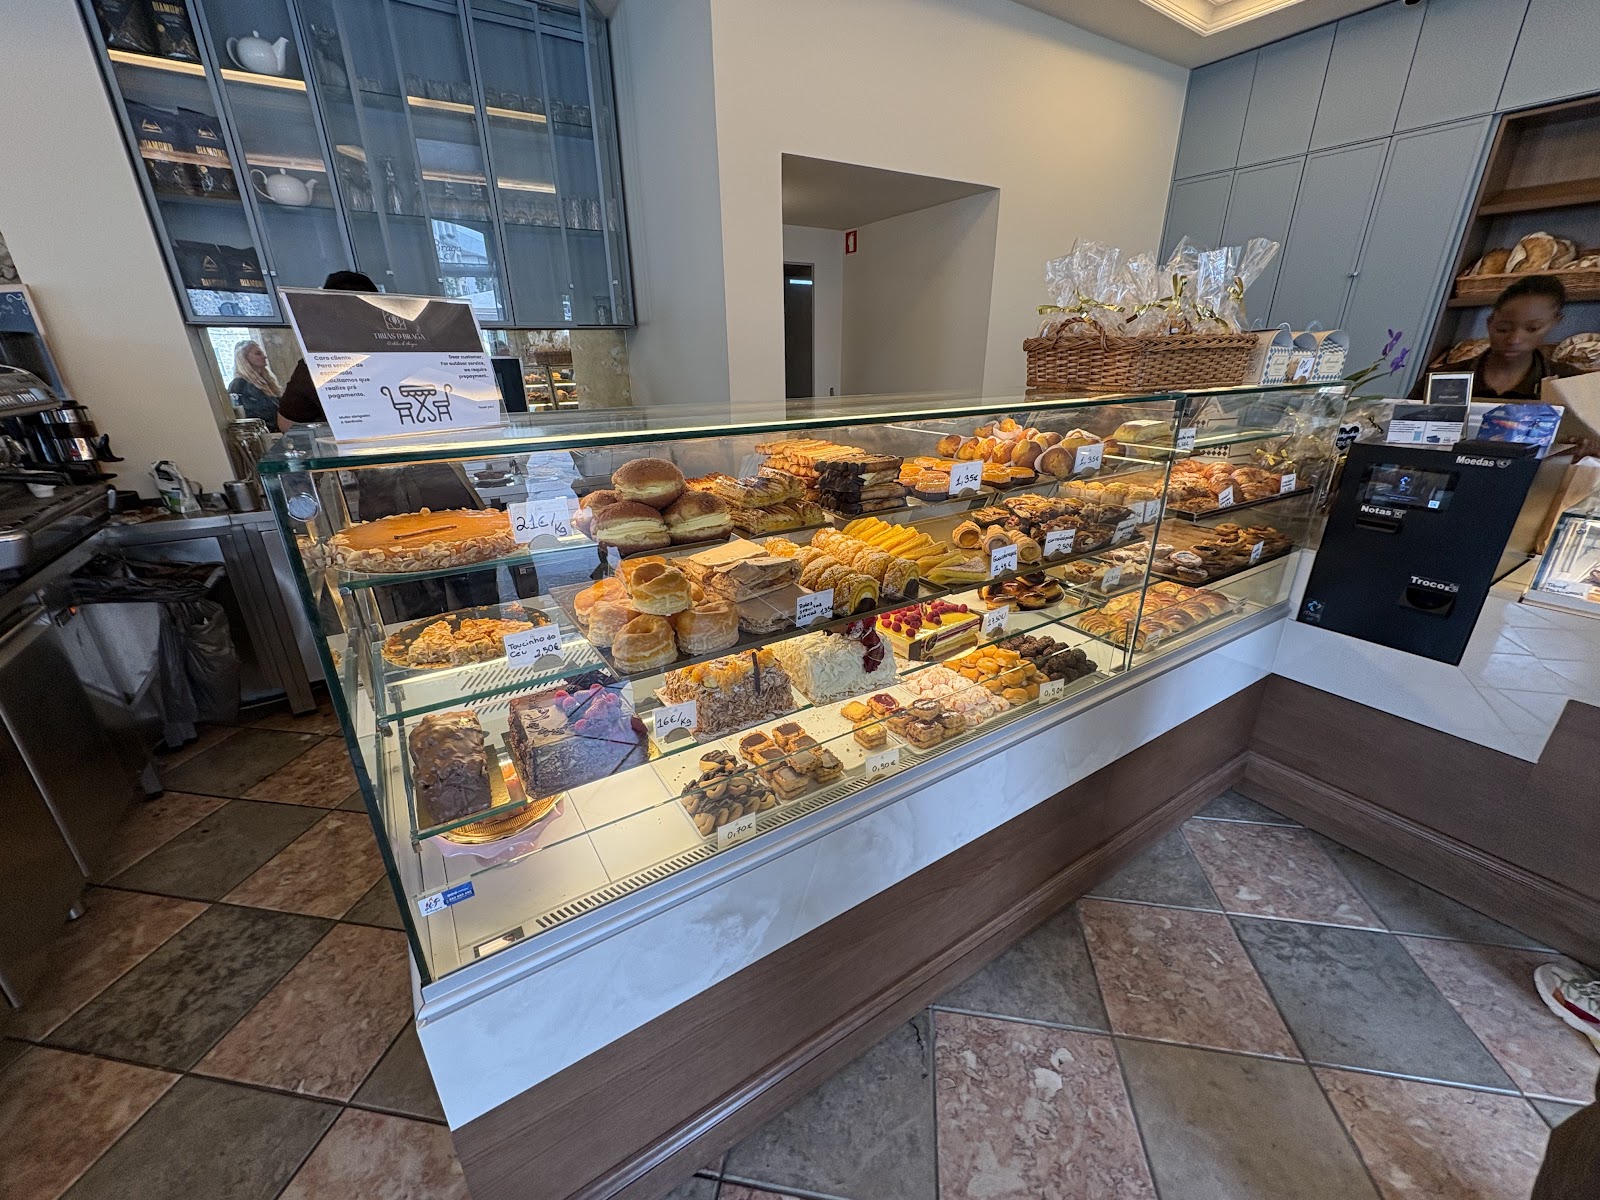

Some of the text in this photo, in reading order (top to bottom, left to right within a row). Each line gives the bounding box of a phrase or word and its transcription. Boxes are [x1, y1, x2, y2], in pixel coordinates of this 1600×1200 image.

[1455, 455, 1495, 467] Moedas
[955, 474, 979, 487] 1,35€
[1360, 505, 1392, 516] Notas
[507, 636, 546, 650] Toucinho
[727, 822, 753, 839] 0,70€
